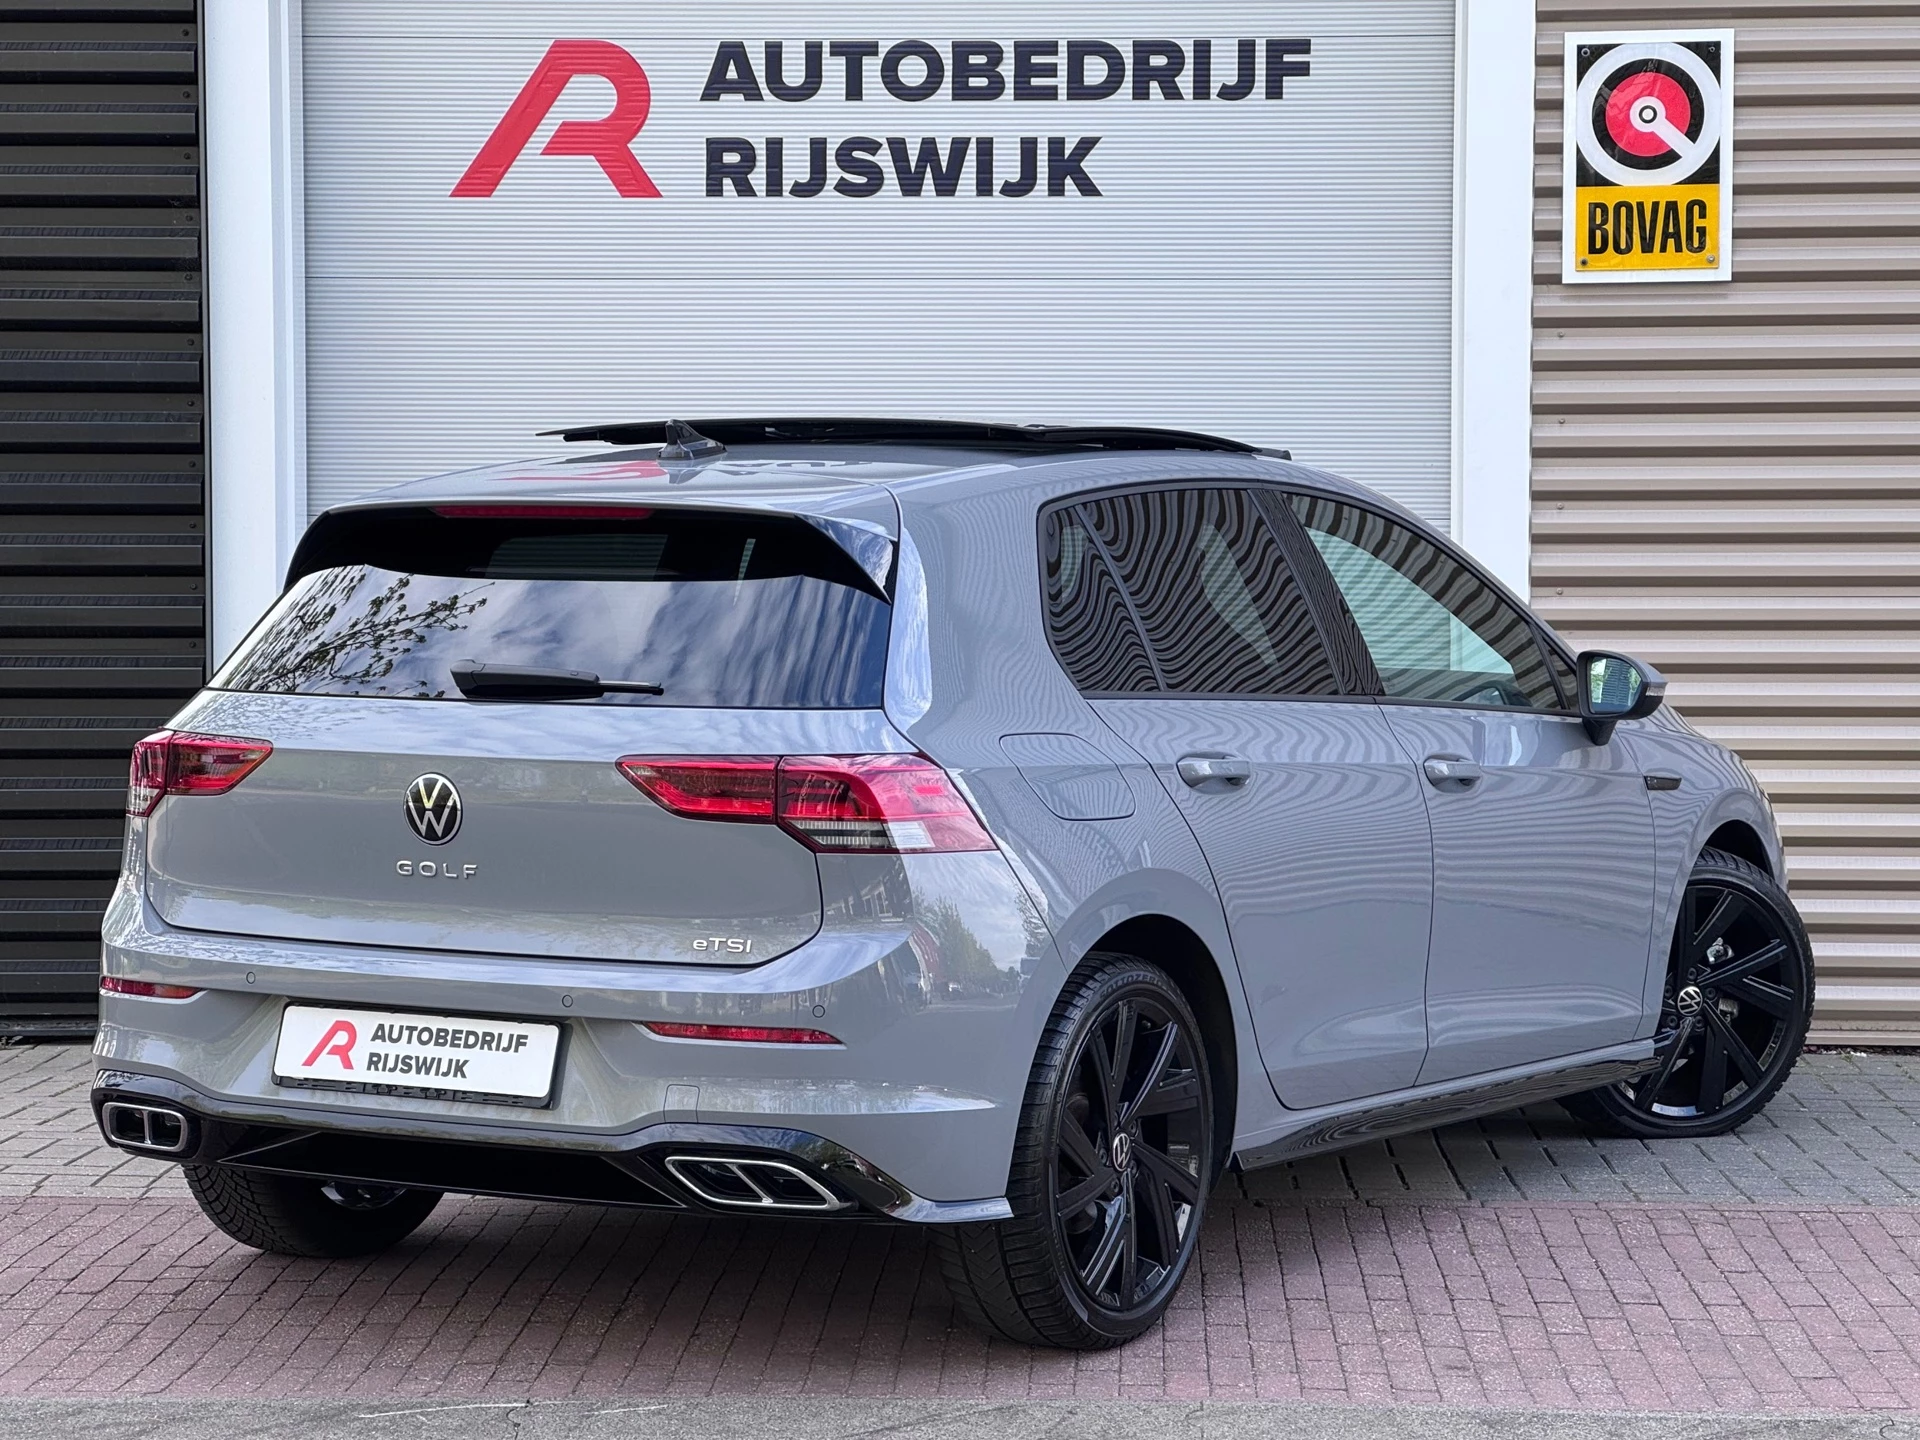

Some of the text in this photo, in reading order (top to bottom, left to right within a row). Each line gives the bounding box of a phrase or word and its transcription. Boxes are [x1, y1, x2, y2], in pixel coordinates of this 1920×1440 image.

[699, 38, 1312, 102] AUTOBEDRIJF
[705, 136, 1103, 198] RIJSWIJK
[1587, 198, 1708, 256] BOVAG
[396, 860, 479, 880] GOLF
[692, 937, 752, 953] eTSI
[370, 1023, 529, 1054] AUTOBEDRIJF
[366, 1052, 471, 1080] RIJSWIJK
